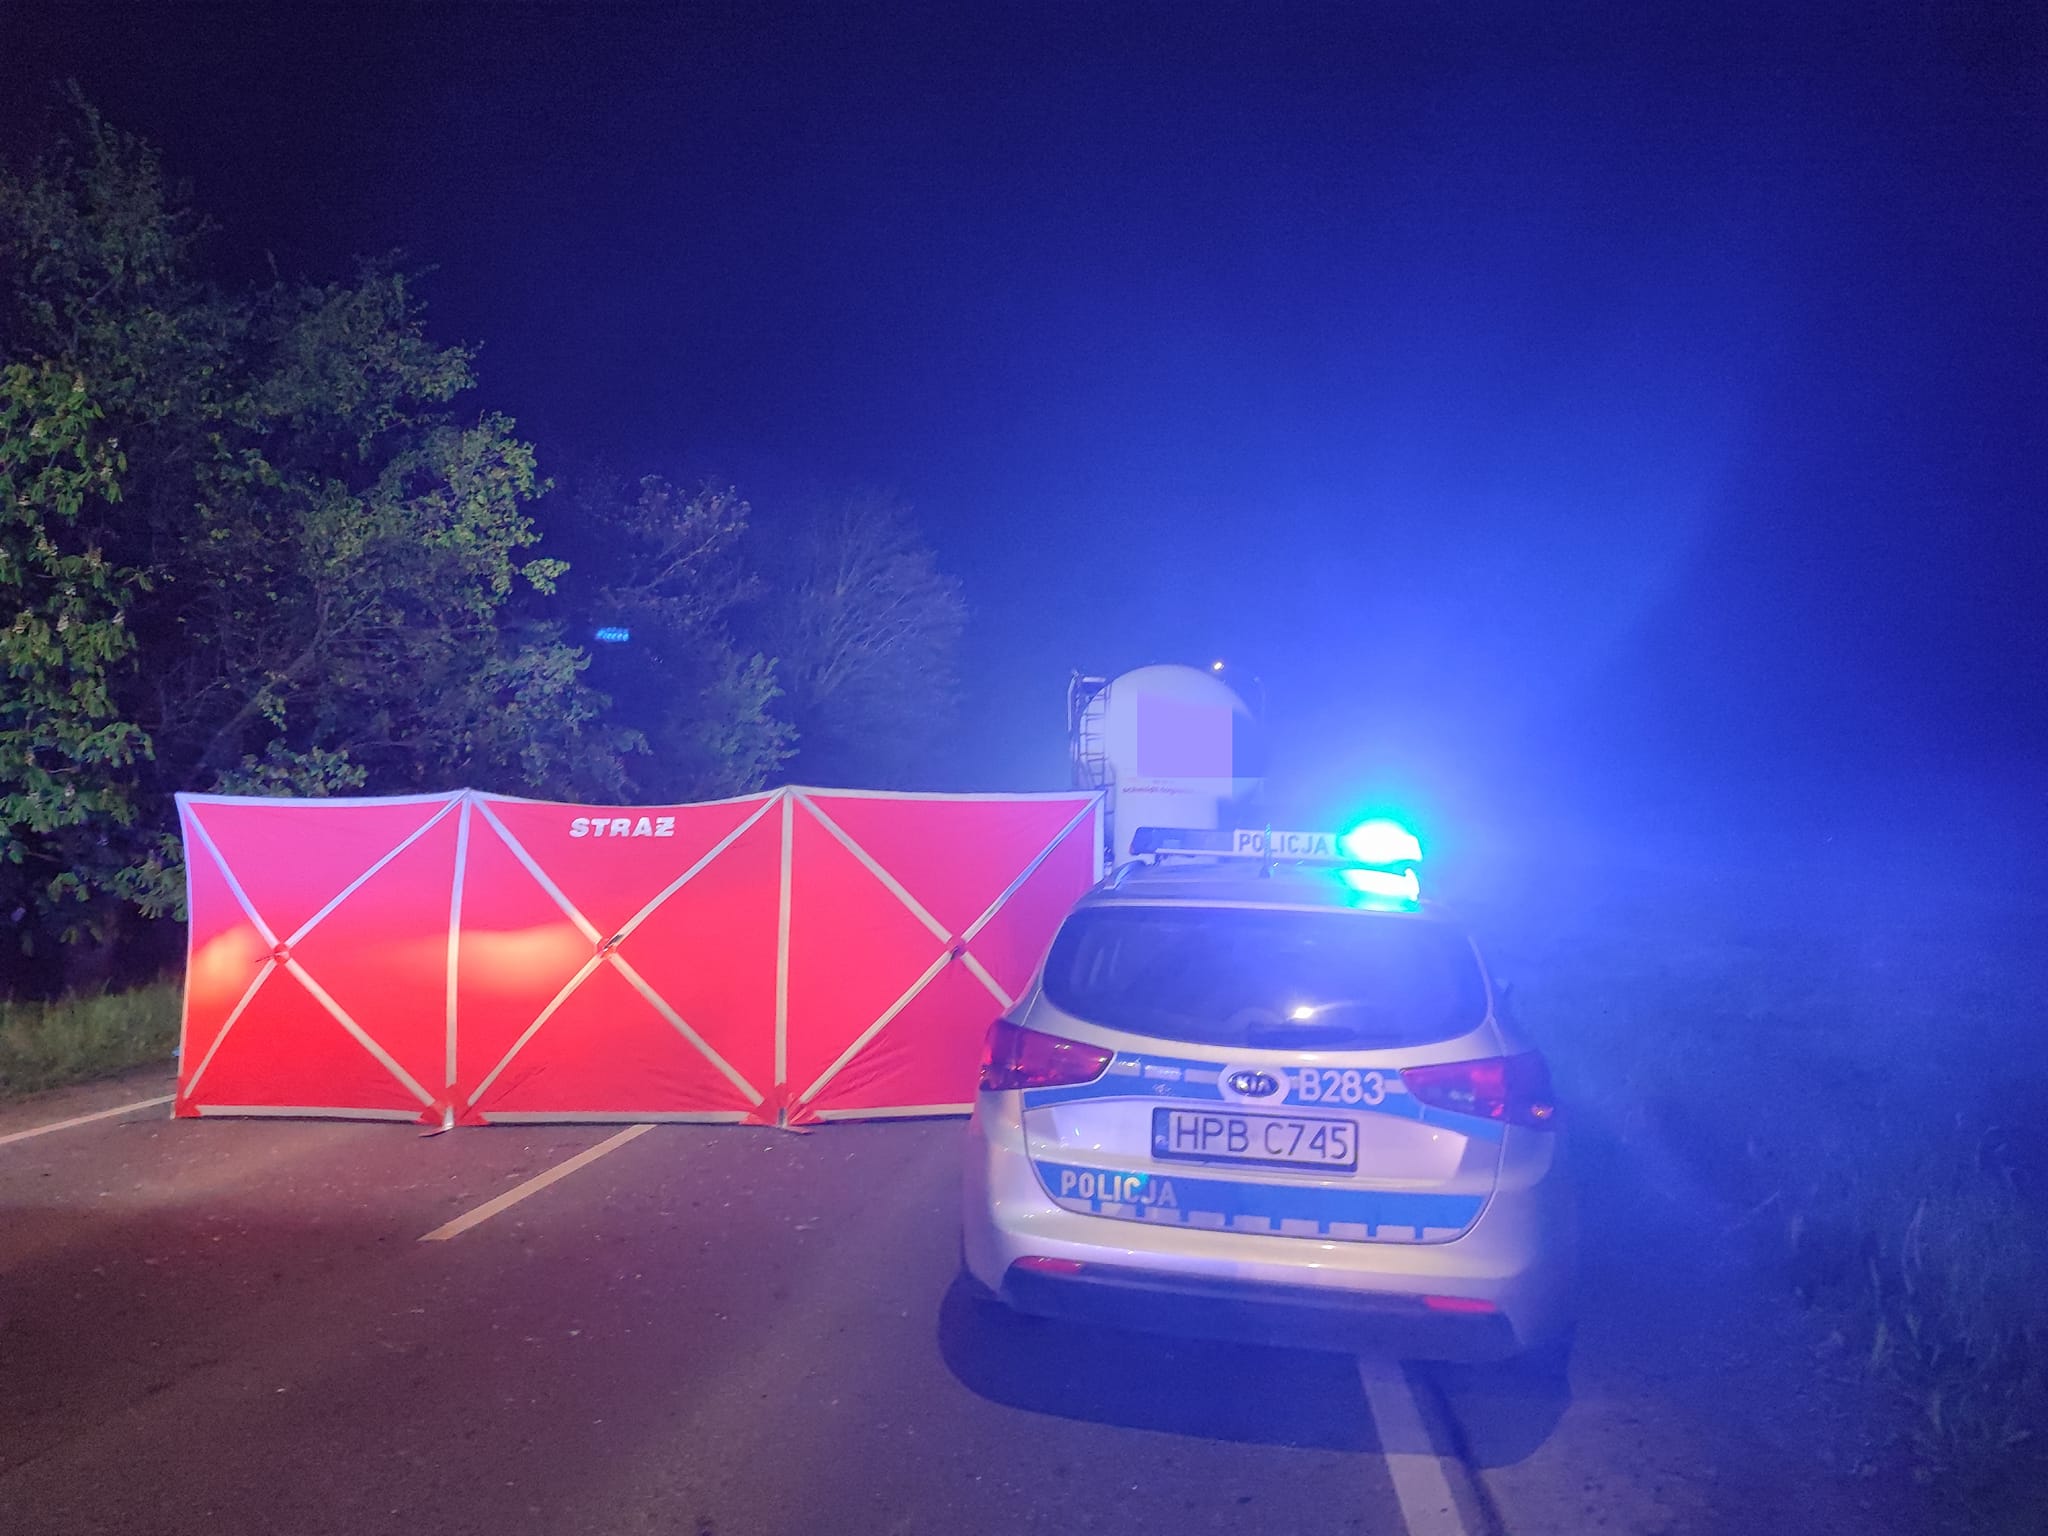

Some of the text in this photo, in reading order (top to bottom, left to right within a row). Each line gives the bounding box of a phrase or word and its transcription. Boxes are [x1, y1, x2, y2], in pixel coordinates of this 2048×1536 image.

[1300, 1069, 1386, 1106] B283
[1176, 1115, 1348, 1160] HPB C745
[1060, 1169, 1178, 1208] POLICJA
